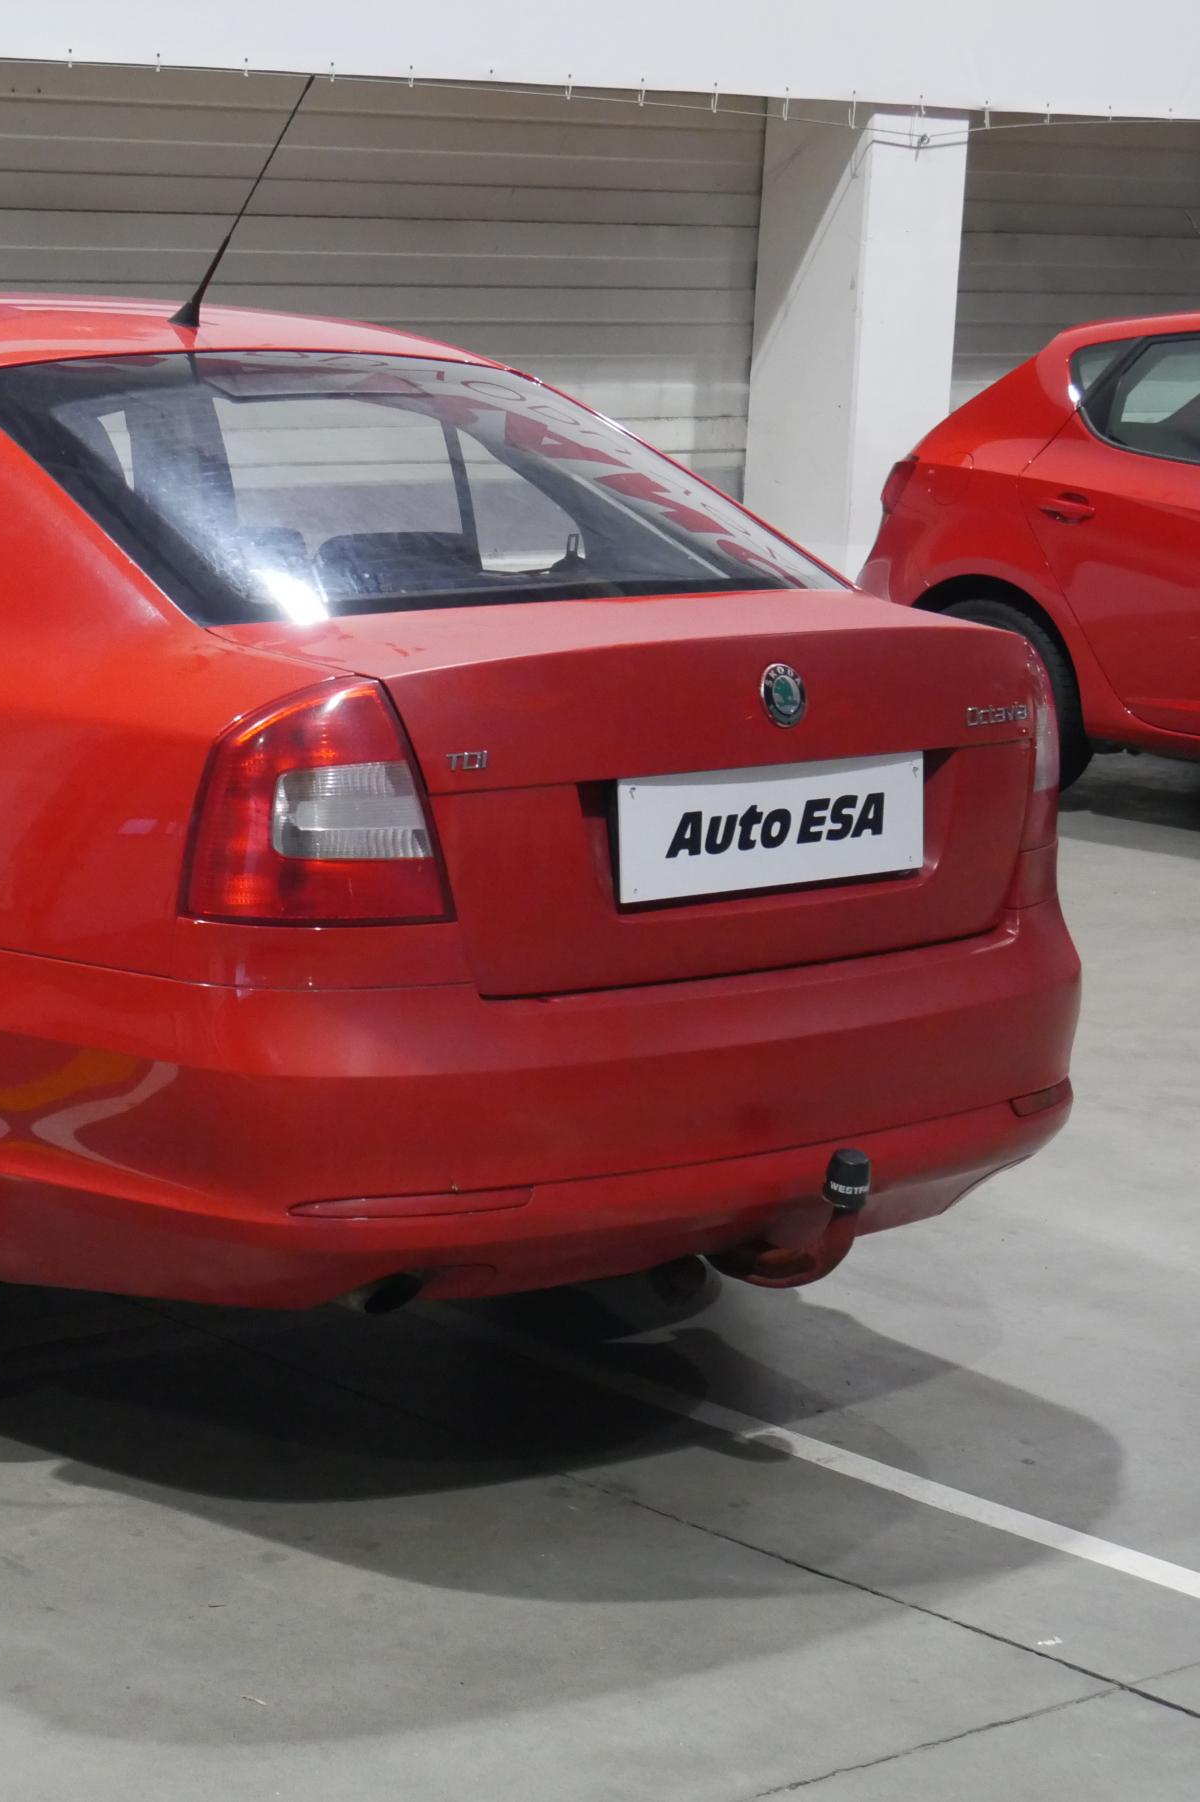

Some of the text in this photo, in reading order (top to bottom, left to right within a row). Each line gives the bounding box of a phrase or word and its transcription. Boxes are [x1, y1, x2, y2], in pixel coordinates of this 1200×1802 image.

[966, 702, 1028, 726] Octavia
[445, 750, 488, 771] TDI
[665, 792, 884, 858] Auto ESA
